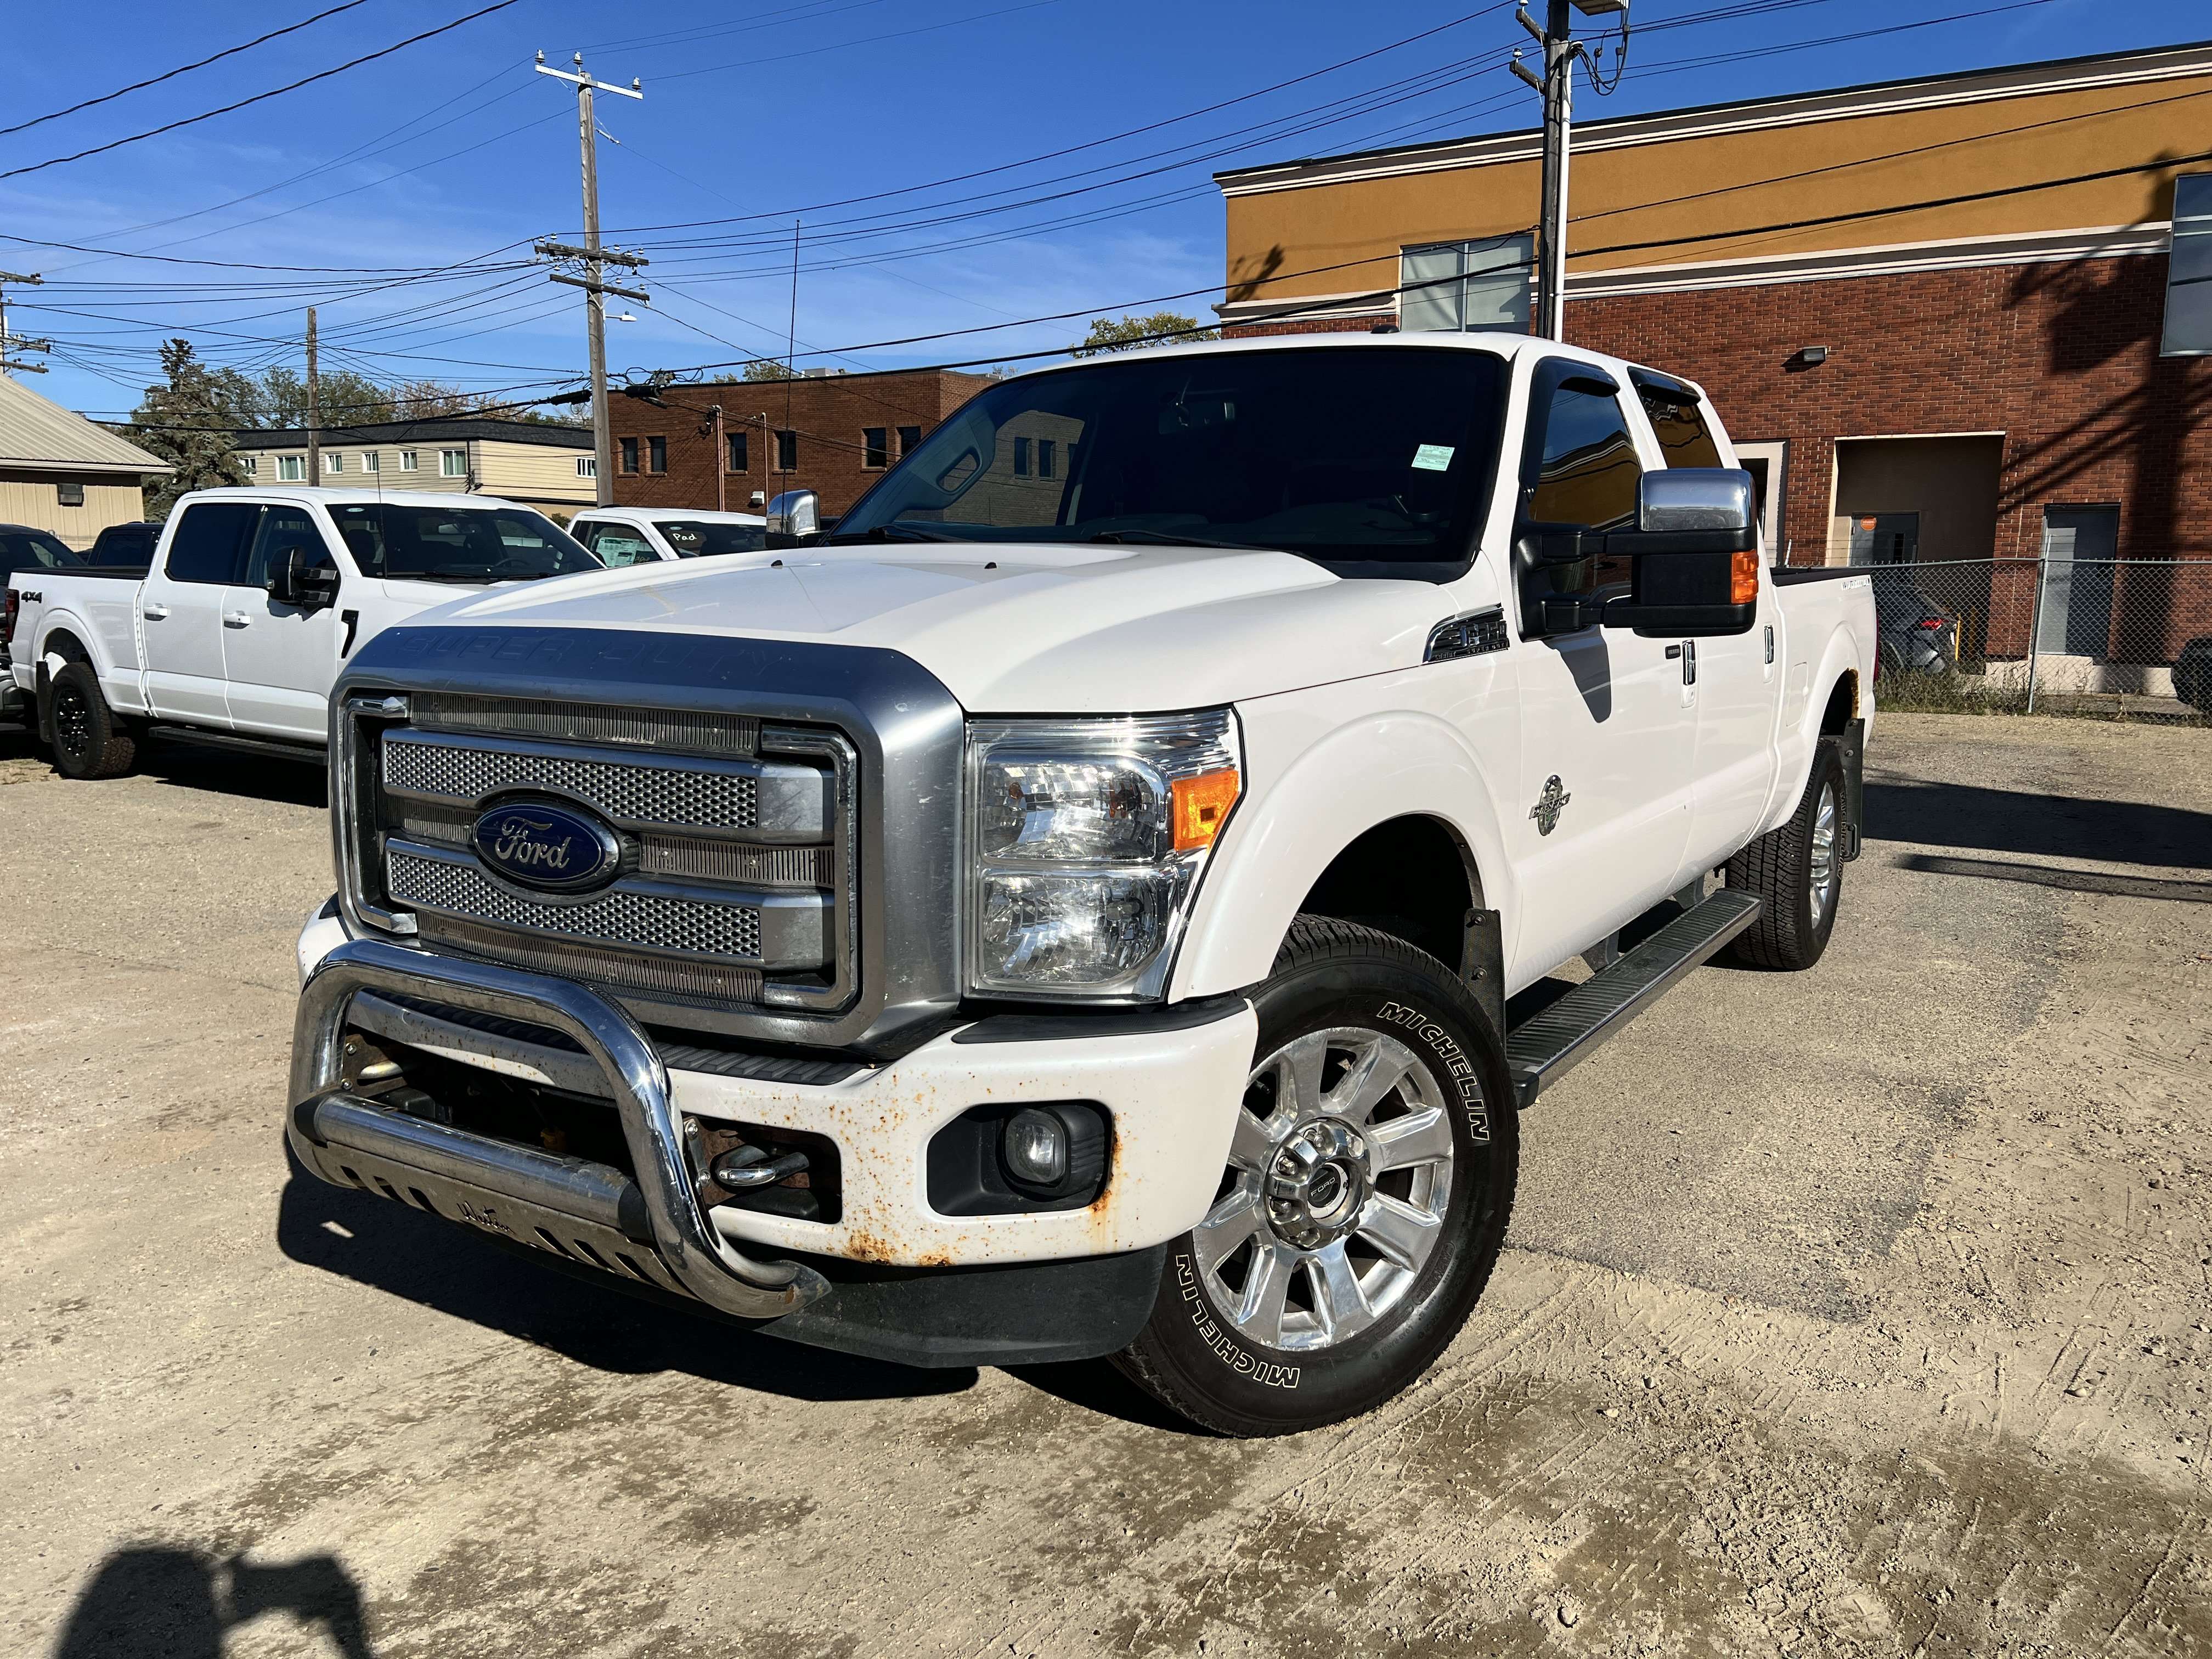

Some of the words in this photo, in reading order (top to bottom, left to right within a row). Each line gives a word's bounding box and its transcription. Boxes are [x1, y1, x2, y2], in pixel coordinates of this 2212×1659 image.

[673, 533, 697, 541] Pad
[403, 633, 575, 664] SUPER
[594, 639, 783, 675] DUTY
[495, 816, 572, 868] Ford
[1376, 1001, 1491, 1142] MICHELIN
[1311, 1177, 1335, 1197] FORD
[456, 1200, 517, 1234] Westin
[1175, 1254, 1301, 1389] MICHELIN
